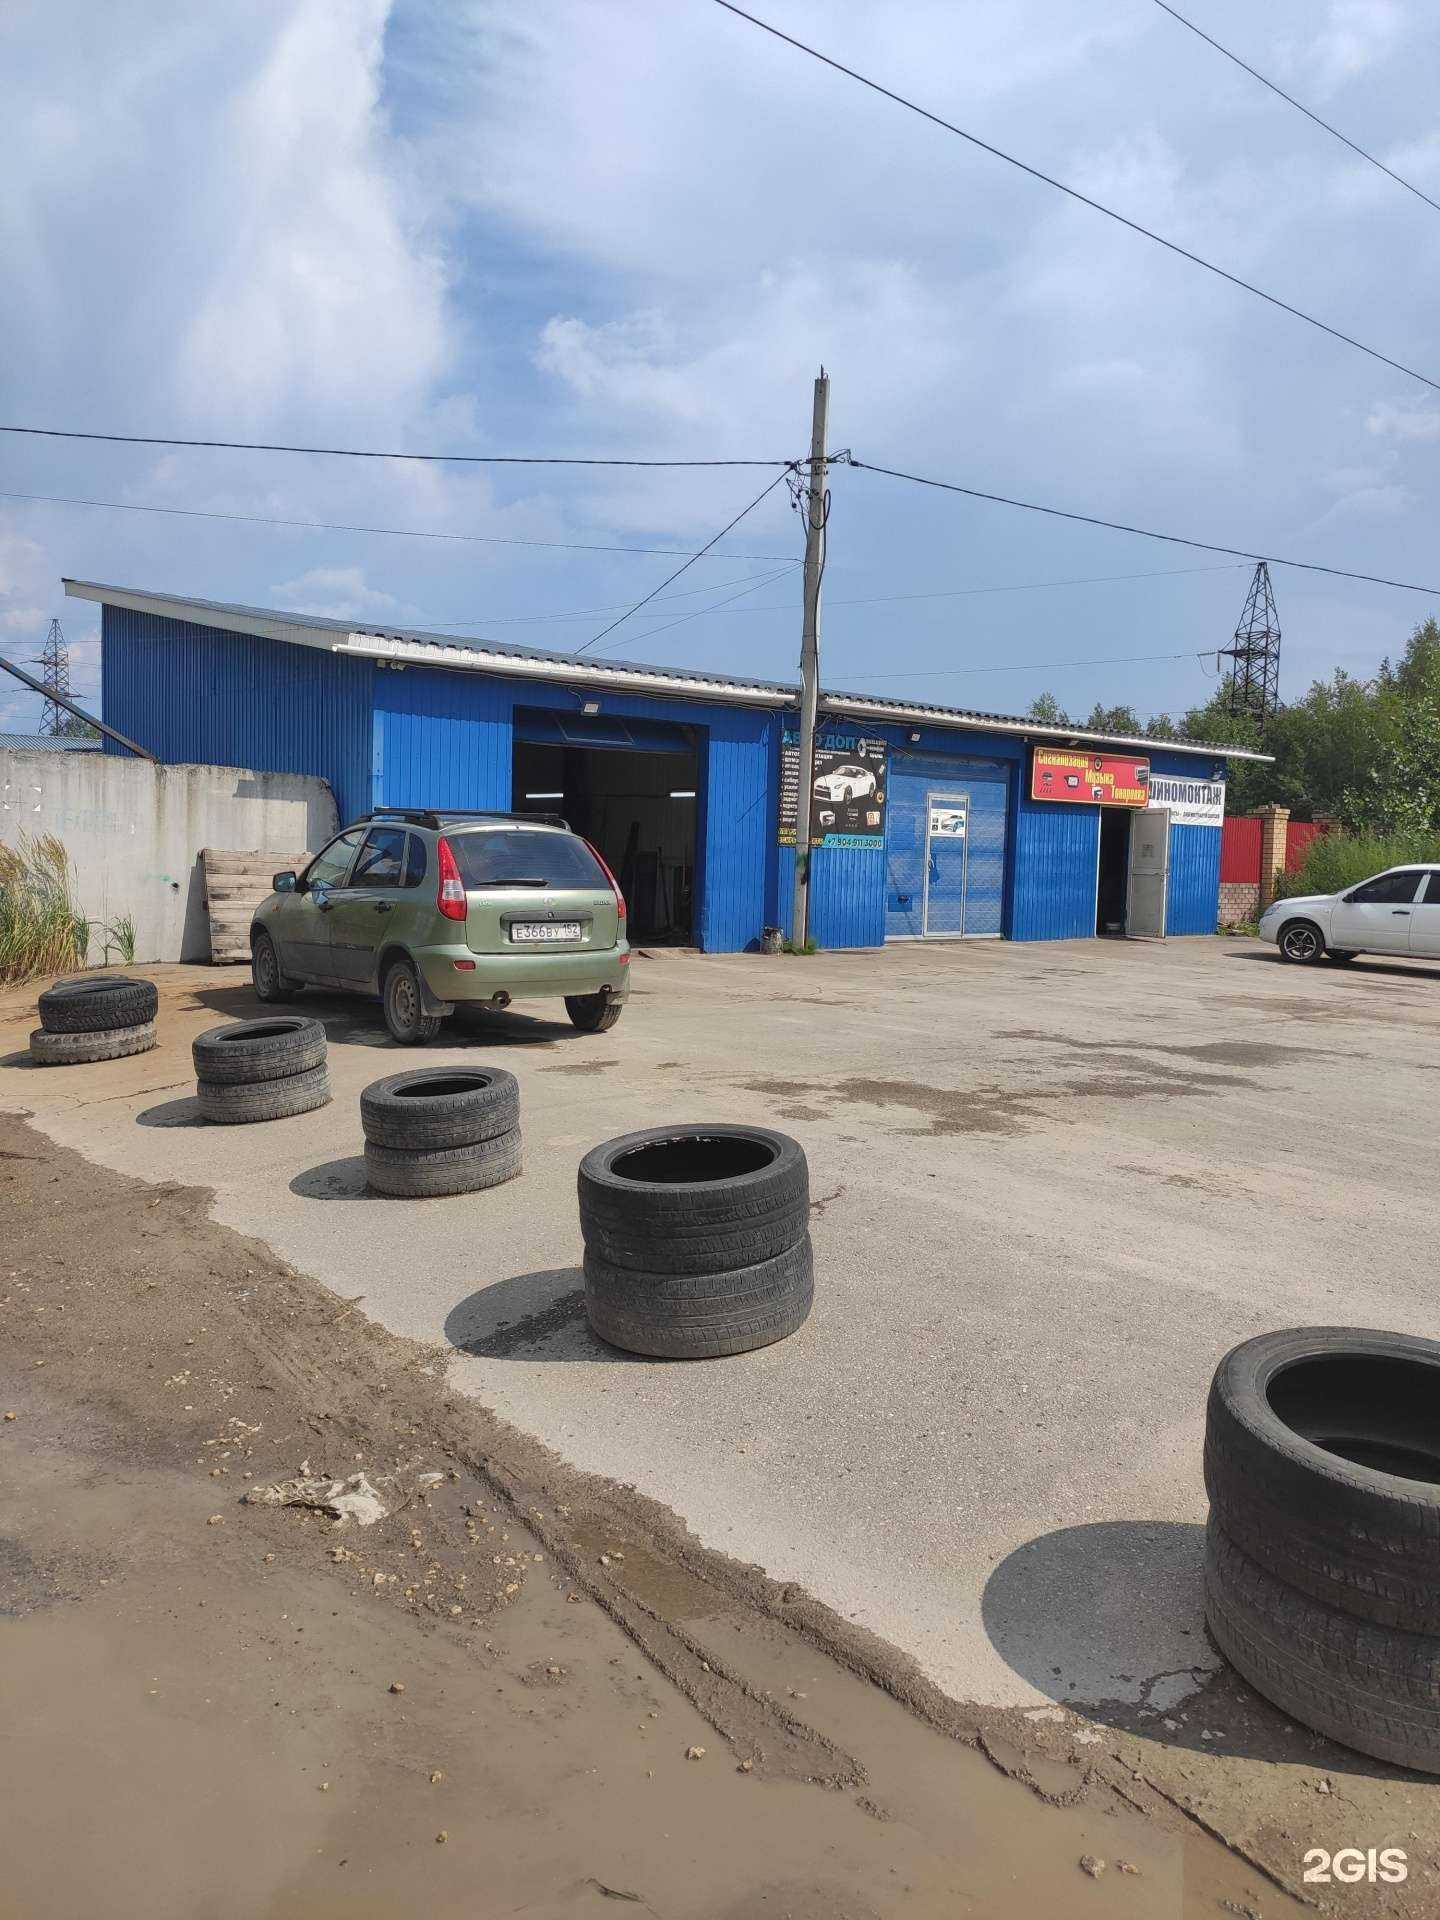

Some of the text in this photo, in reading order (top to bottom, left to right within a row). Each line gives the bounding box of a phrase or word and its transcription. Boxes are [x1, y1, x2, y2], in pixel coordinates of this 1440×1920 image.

[782, 730, 822, 746] АВО
[825, 735, 856, 751] ДОП
[1084, 768, 1115, 786] Музыка
[562, 923, 578, 935] 152
